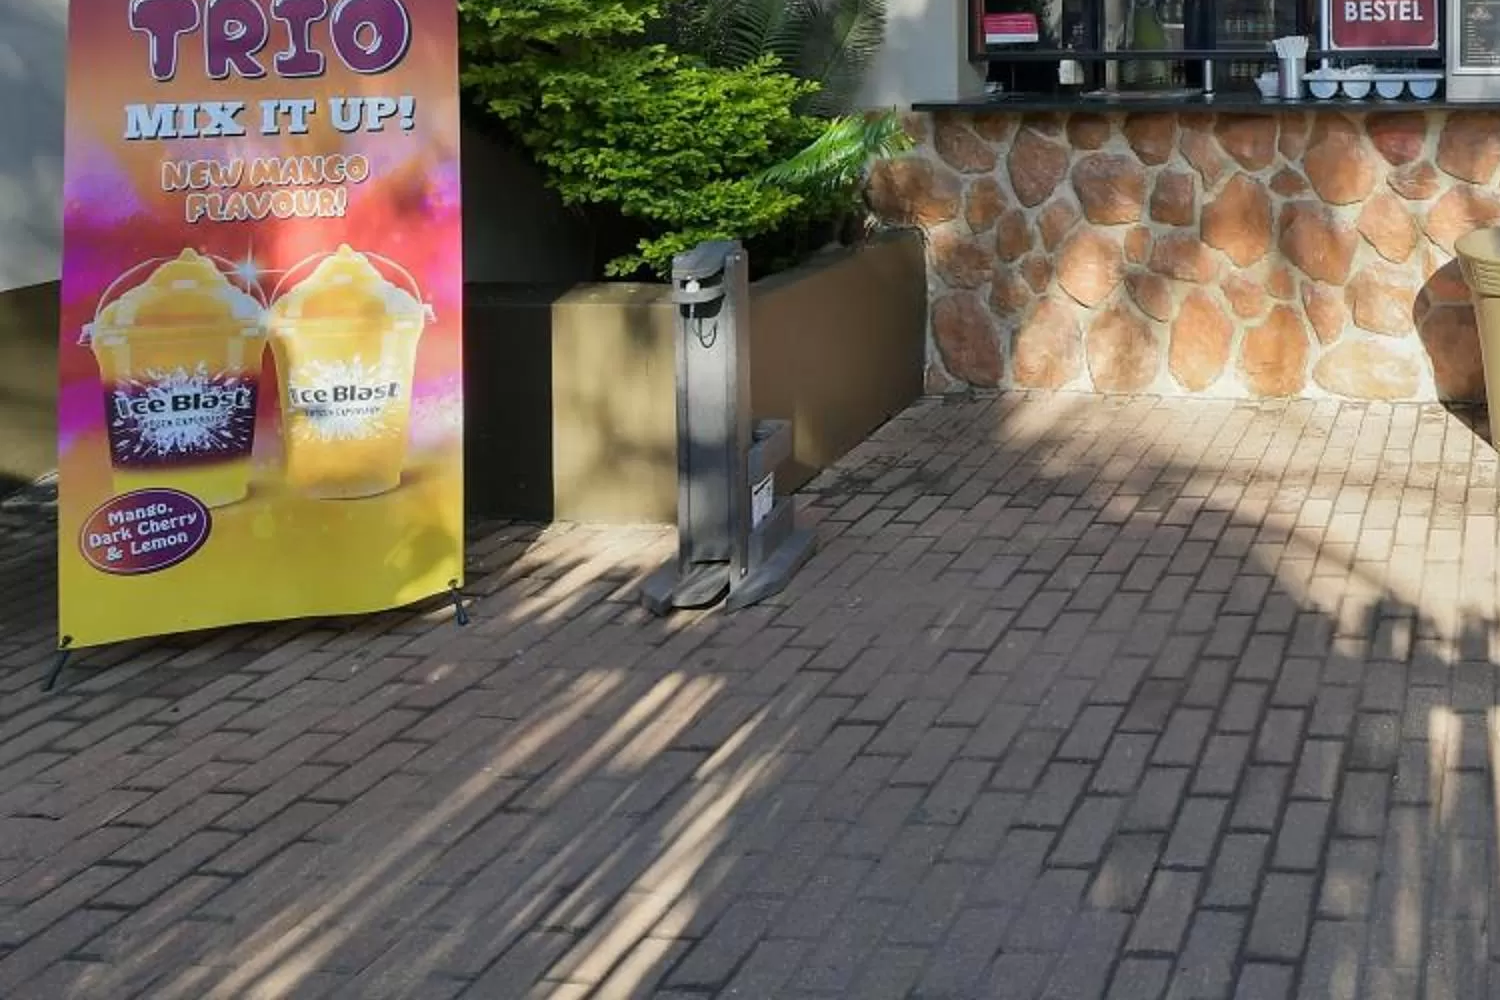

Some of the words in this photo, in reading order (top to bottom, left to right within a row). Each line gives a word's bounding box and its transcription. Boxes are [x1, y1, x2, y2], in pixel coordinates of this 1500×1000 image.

[1345, 0, 1423, 21] BESTEL
[125, 103, 246, 141] MIX
[259, 99, 316, 134] IT
[330, 96, 416, 132] UP!
[162, 158, 244, 191] NEW
[251, 154, 369, 186] MANGO
[186, 188, 347, 223] FLAVOUR!
[116, 395, 164, 417] Ice
[171, 390, 250, 411] Blast
[289, 387, 327, 404] Ice
[333, 382, 399, 402] Blast
[89, 527, 132, 548] Dark
[137, 512, 197, 535] Cherry
[107, 546, 122, 561] &
[131, 532, 188, 555] Lemon
